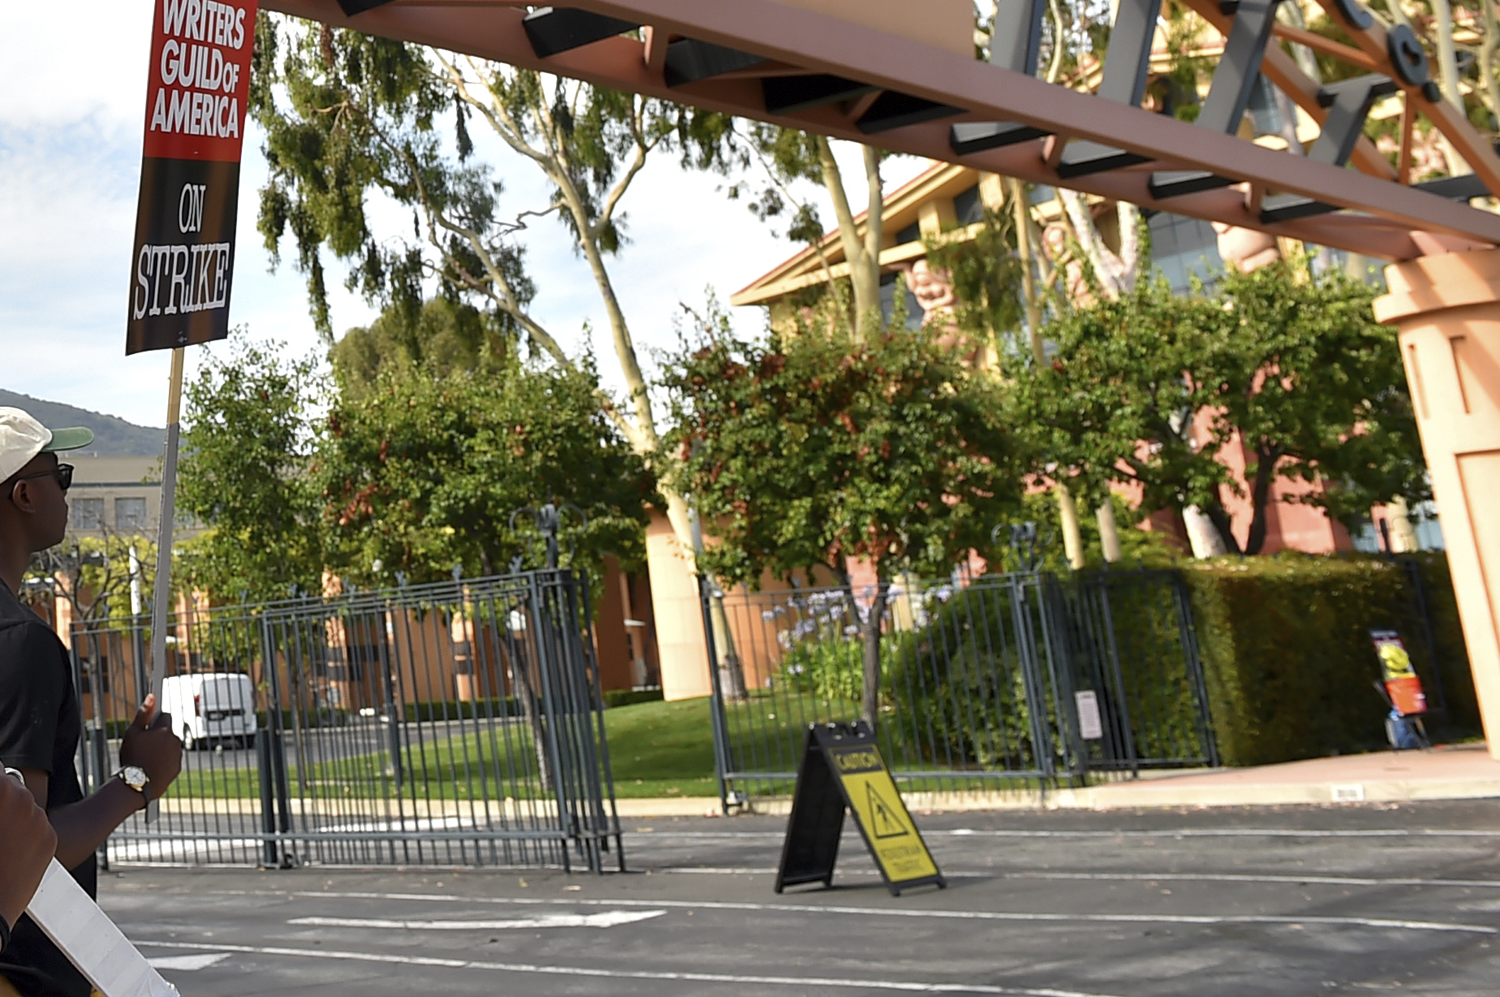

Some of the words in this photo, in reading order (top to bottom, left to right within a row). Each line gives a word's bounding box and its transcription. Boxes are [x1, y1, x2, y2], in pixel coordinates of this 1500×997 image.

[160, 38, 224, 91] GUILD
[222, 63, 240, 95] OF
[149, 87, 240, 140] AMERICA
[178, 182, 207, 234] ON
[132, 241, 231, 321] STRIKE
[835, 751, 879, 771] CAUTION
